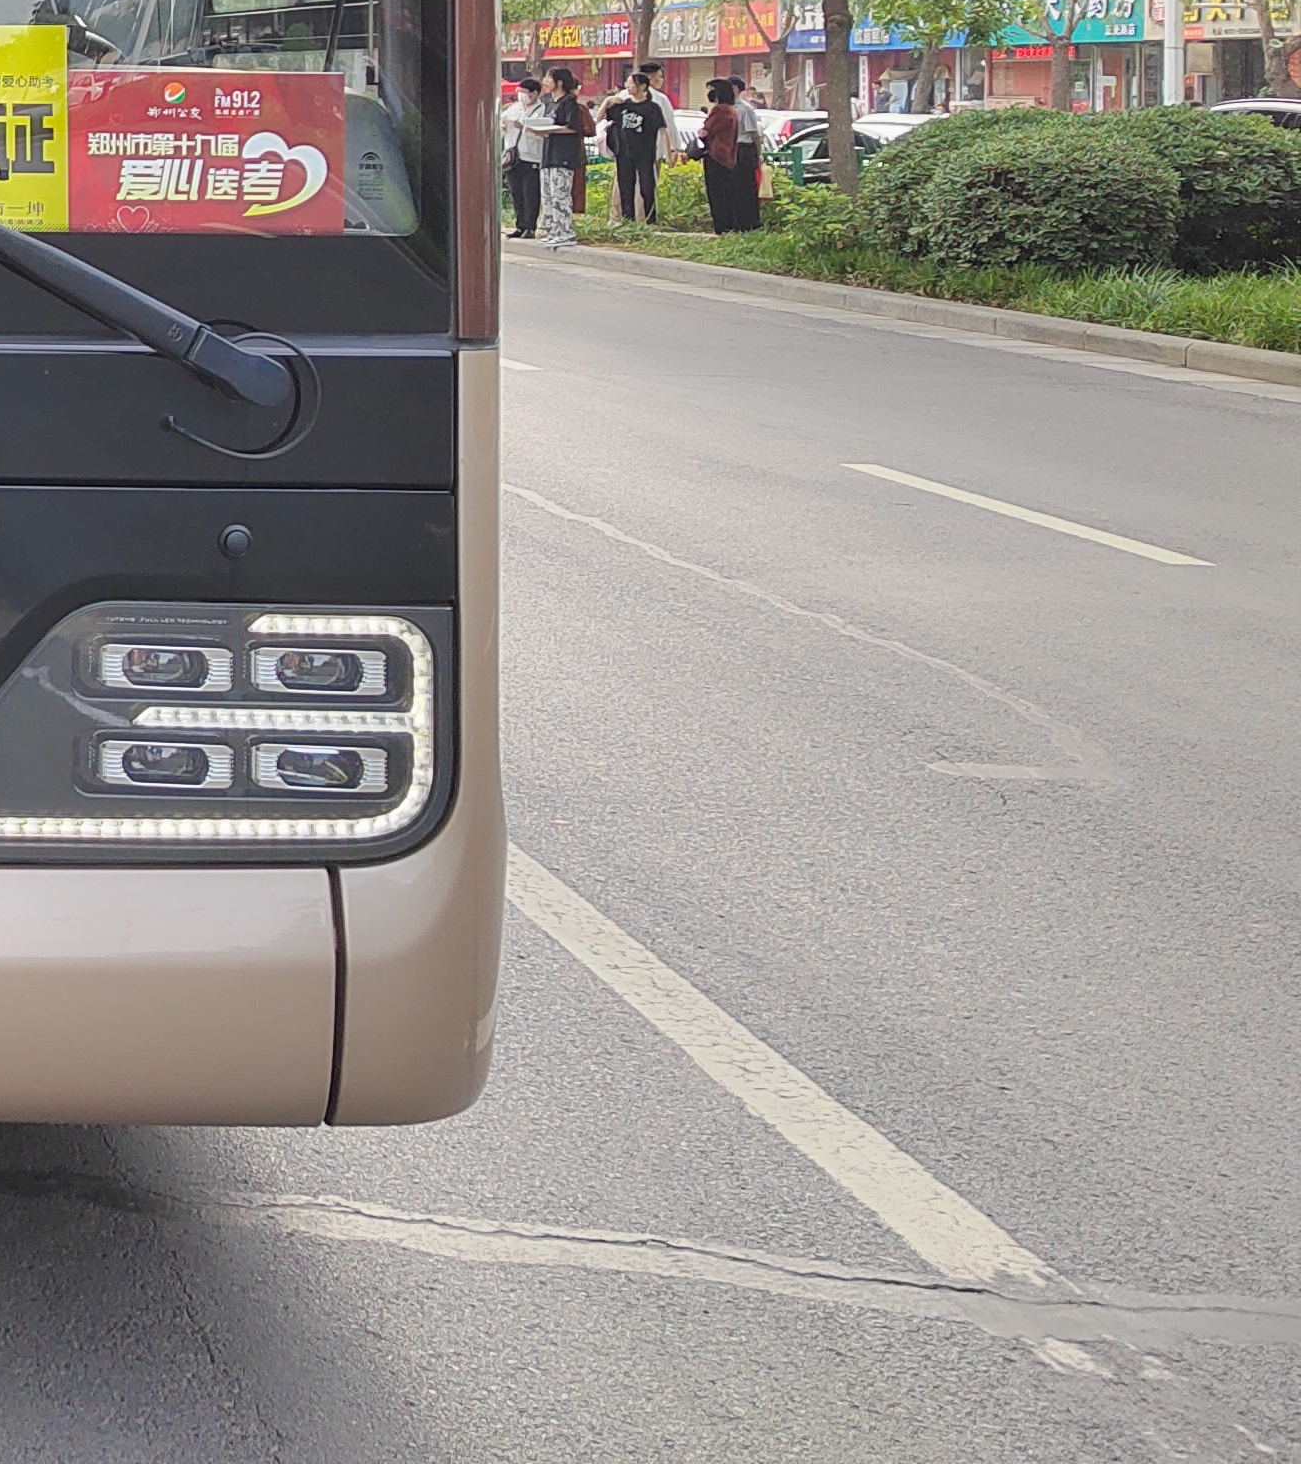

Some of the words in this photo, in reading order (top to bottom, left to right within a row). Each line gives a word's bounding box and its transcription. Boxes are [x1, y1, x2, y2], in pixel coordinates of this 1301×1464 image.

[87, 132, 239, 157] 郑州市第十九届
